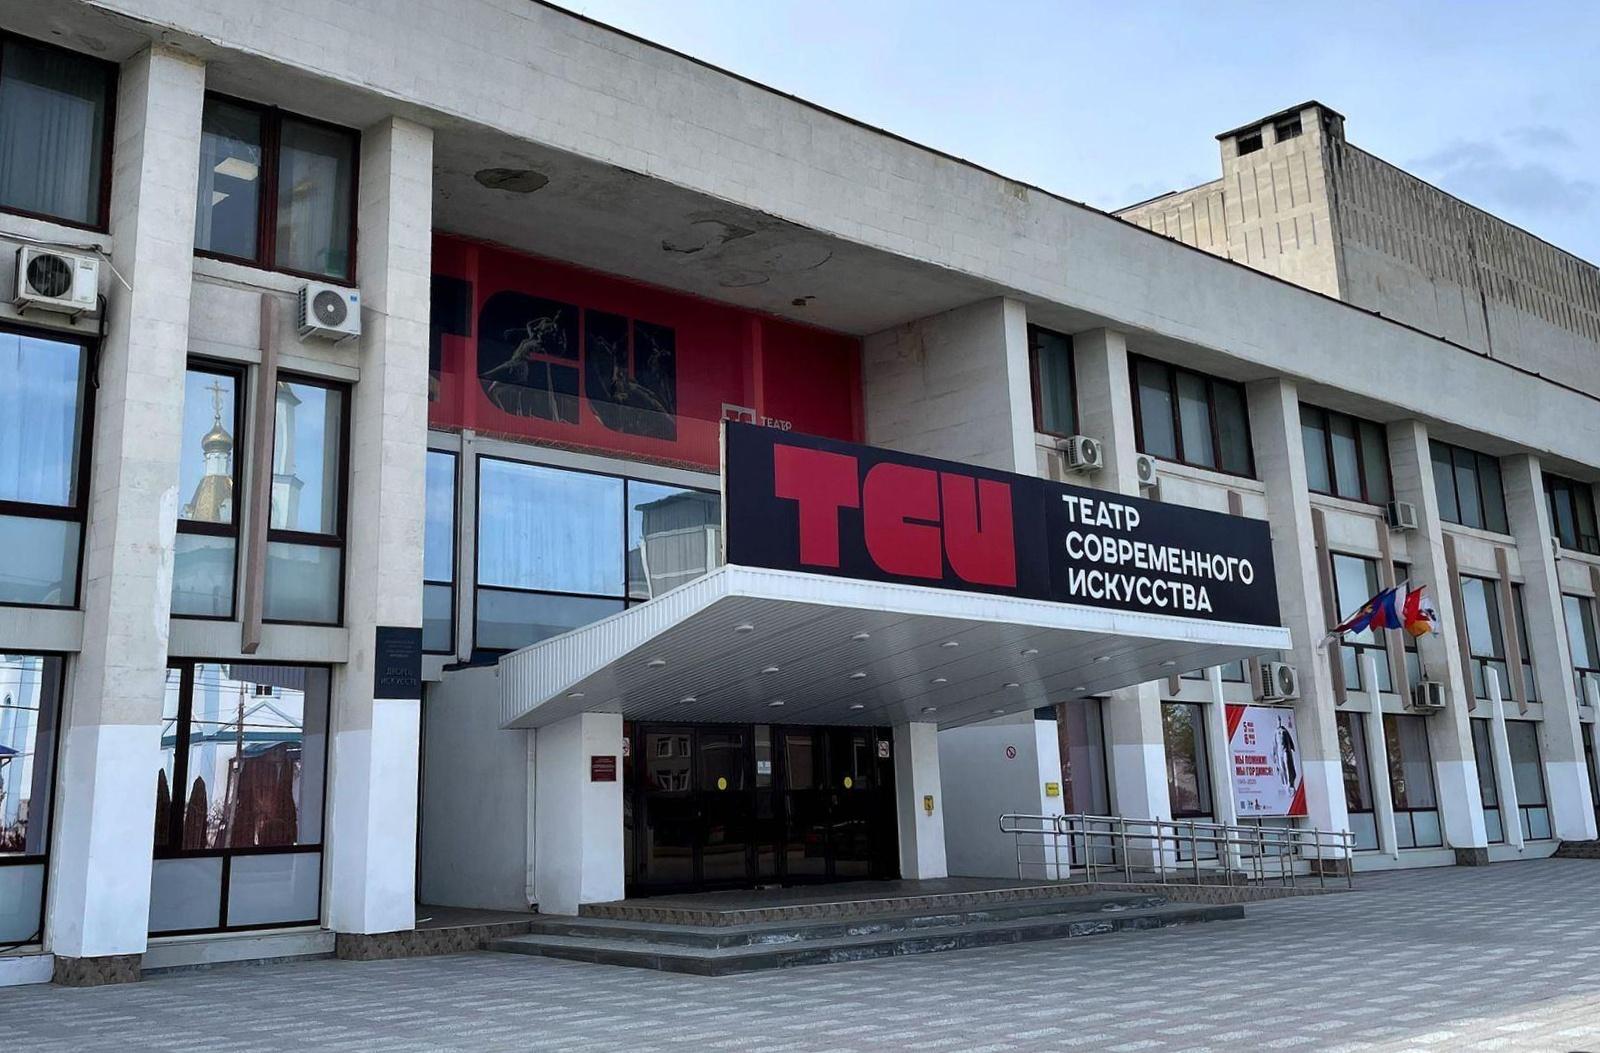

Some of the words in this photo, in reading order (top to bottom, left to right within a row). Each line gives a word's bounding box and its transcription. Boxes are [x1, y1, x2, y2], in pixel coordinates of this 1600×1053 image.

[760, 416, 792, 432] ТЕАТР
[774, 444, 1017, 588] ТСИ
[1062, 494, 1140, 532] ТЕАТР
[1065, 530, 1254, 585] СОВРЕМЕННОГО
[1068, 567, 1213, 613] ИСКУССТВА
